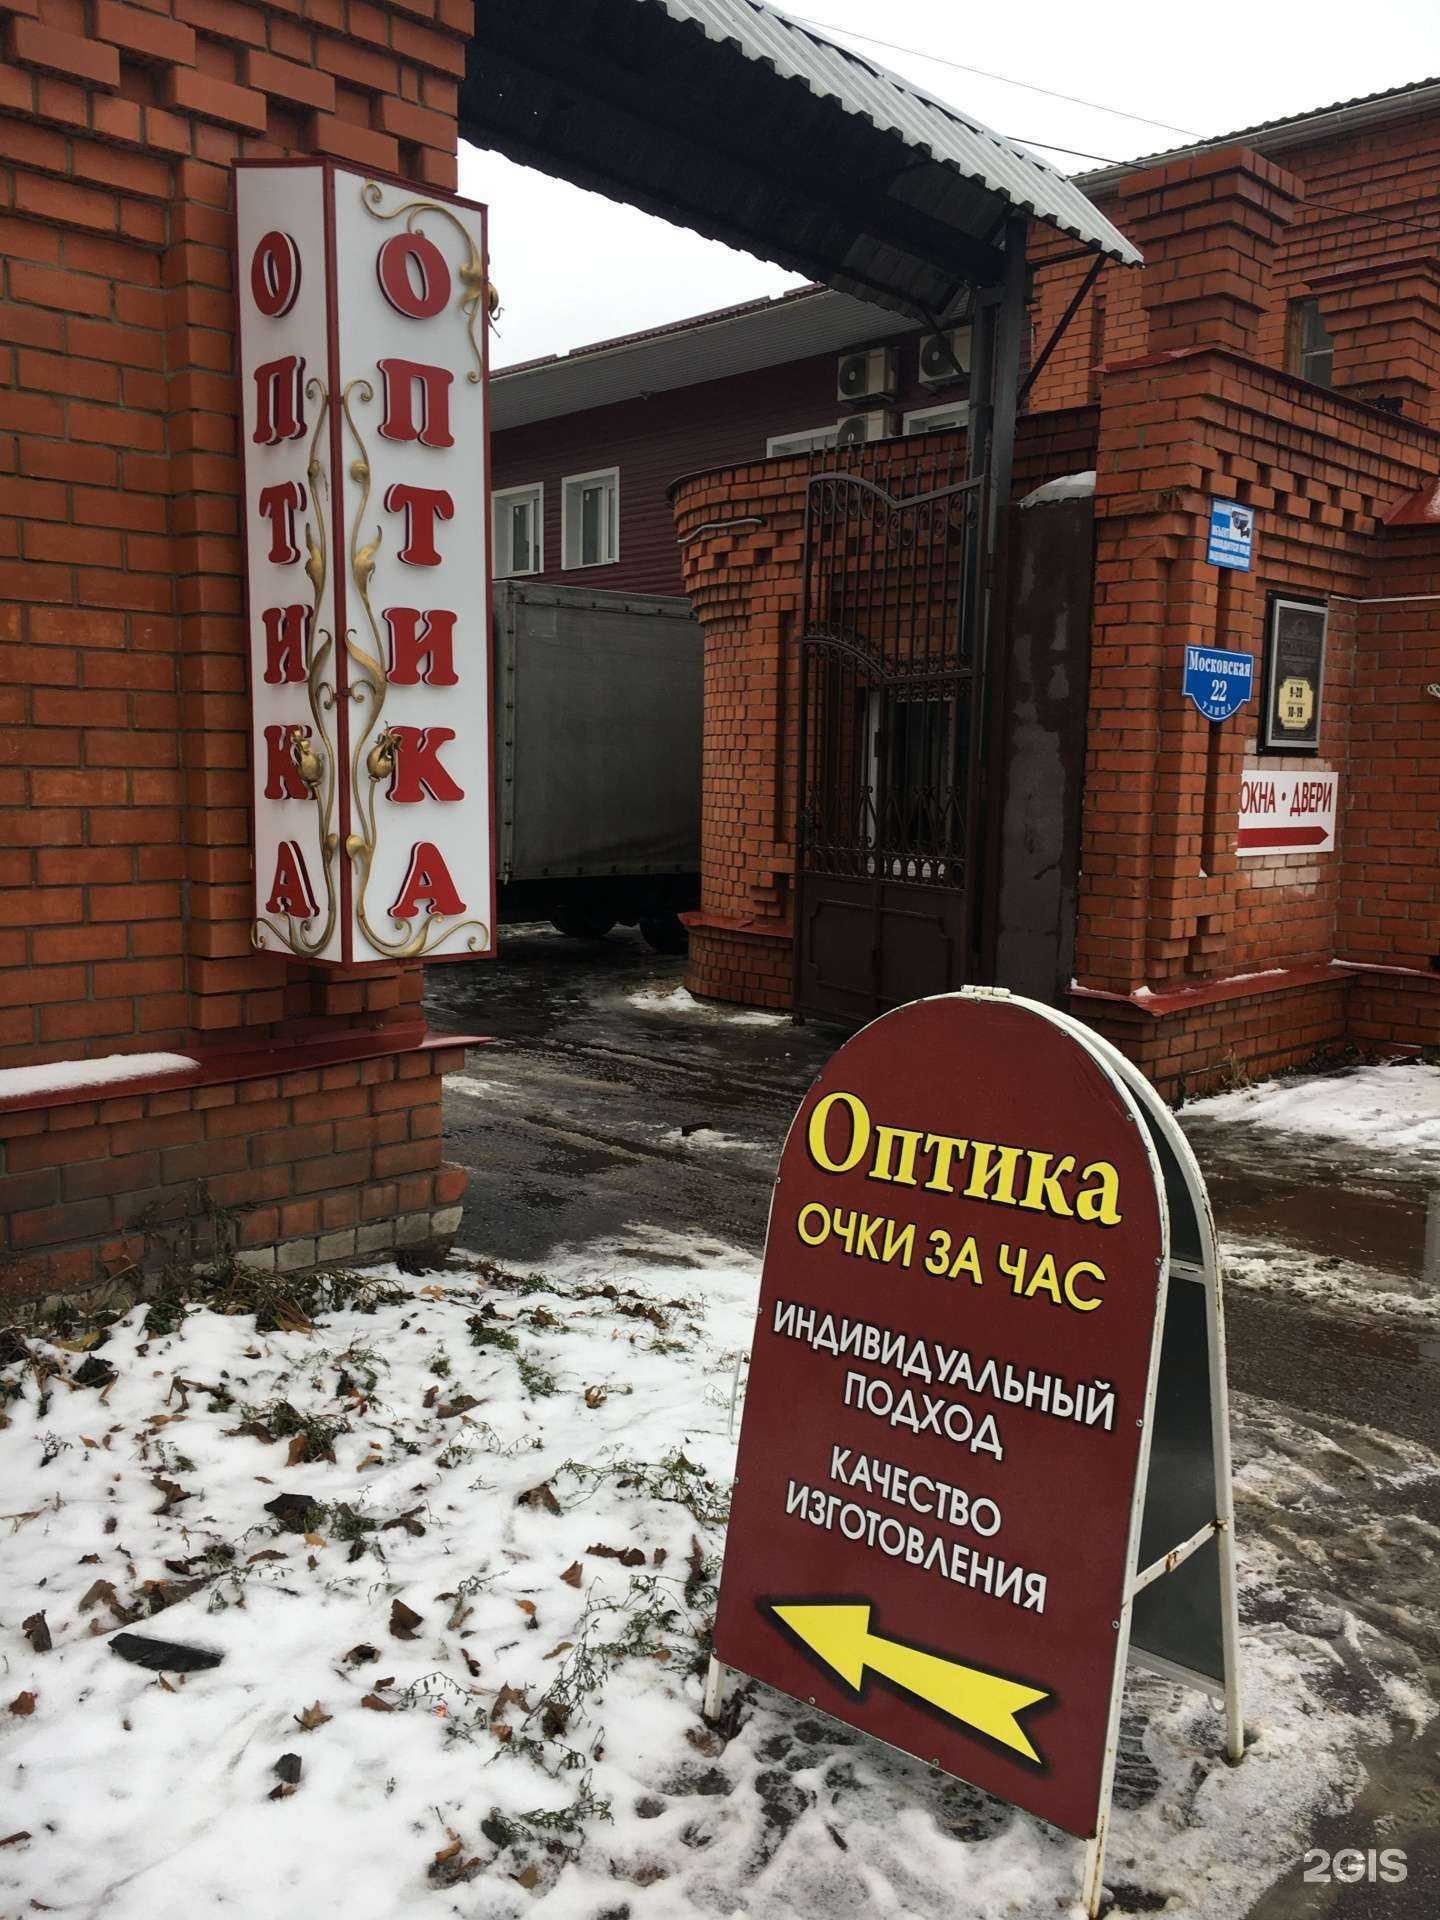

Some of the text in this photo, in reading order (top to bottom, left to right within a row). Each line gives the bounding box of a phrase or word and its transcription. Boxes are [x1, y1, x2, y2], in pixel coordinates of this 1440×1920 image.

[251, 231, 320, 917] ОПТИКА
[377, 232, 467, 918] ОПТИКА
[1188, 651, 1251, 677] Московская
[1210, 680, 1228, 702] 22
[1240, 781, 1333, 817] ОКНА ДВЕРИ
[807, 1091, 1123, 1226] Оптика
[797, 1202, 1107, 1312] ОЧКИ ЗА ЧАС
[772, 1300, 1116, 1431] ИНДИВИДУАЛЬНЫЙ
[843, 1371, 1003, 1461] ПОДХОД
[829, 1445, 1002, 1537] КАЧЕСТВО
[785, 1480, 1048, 1615] ИЗГОТОВЛЕНИЯ
